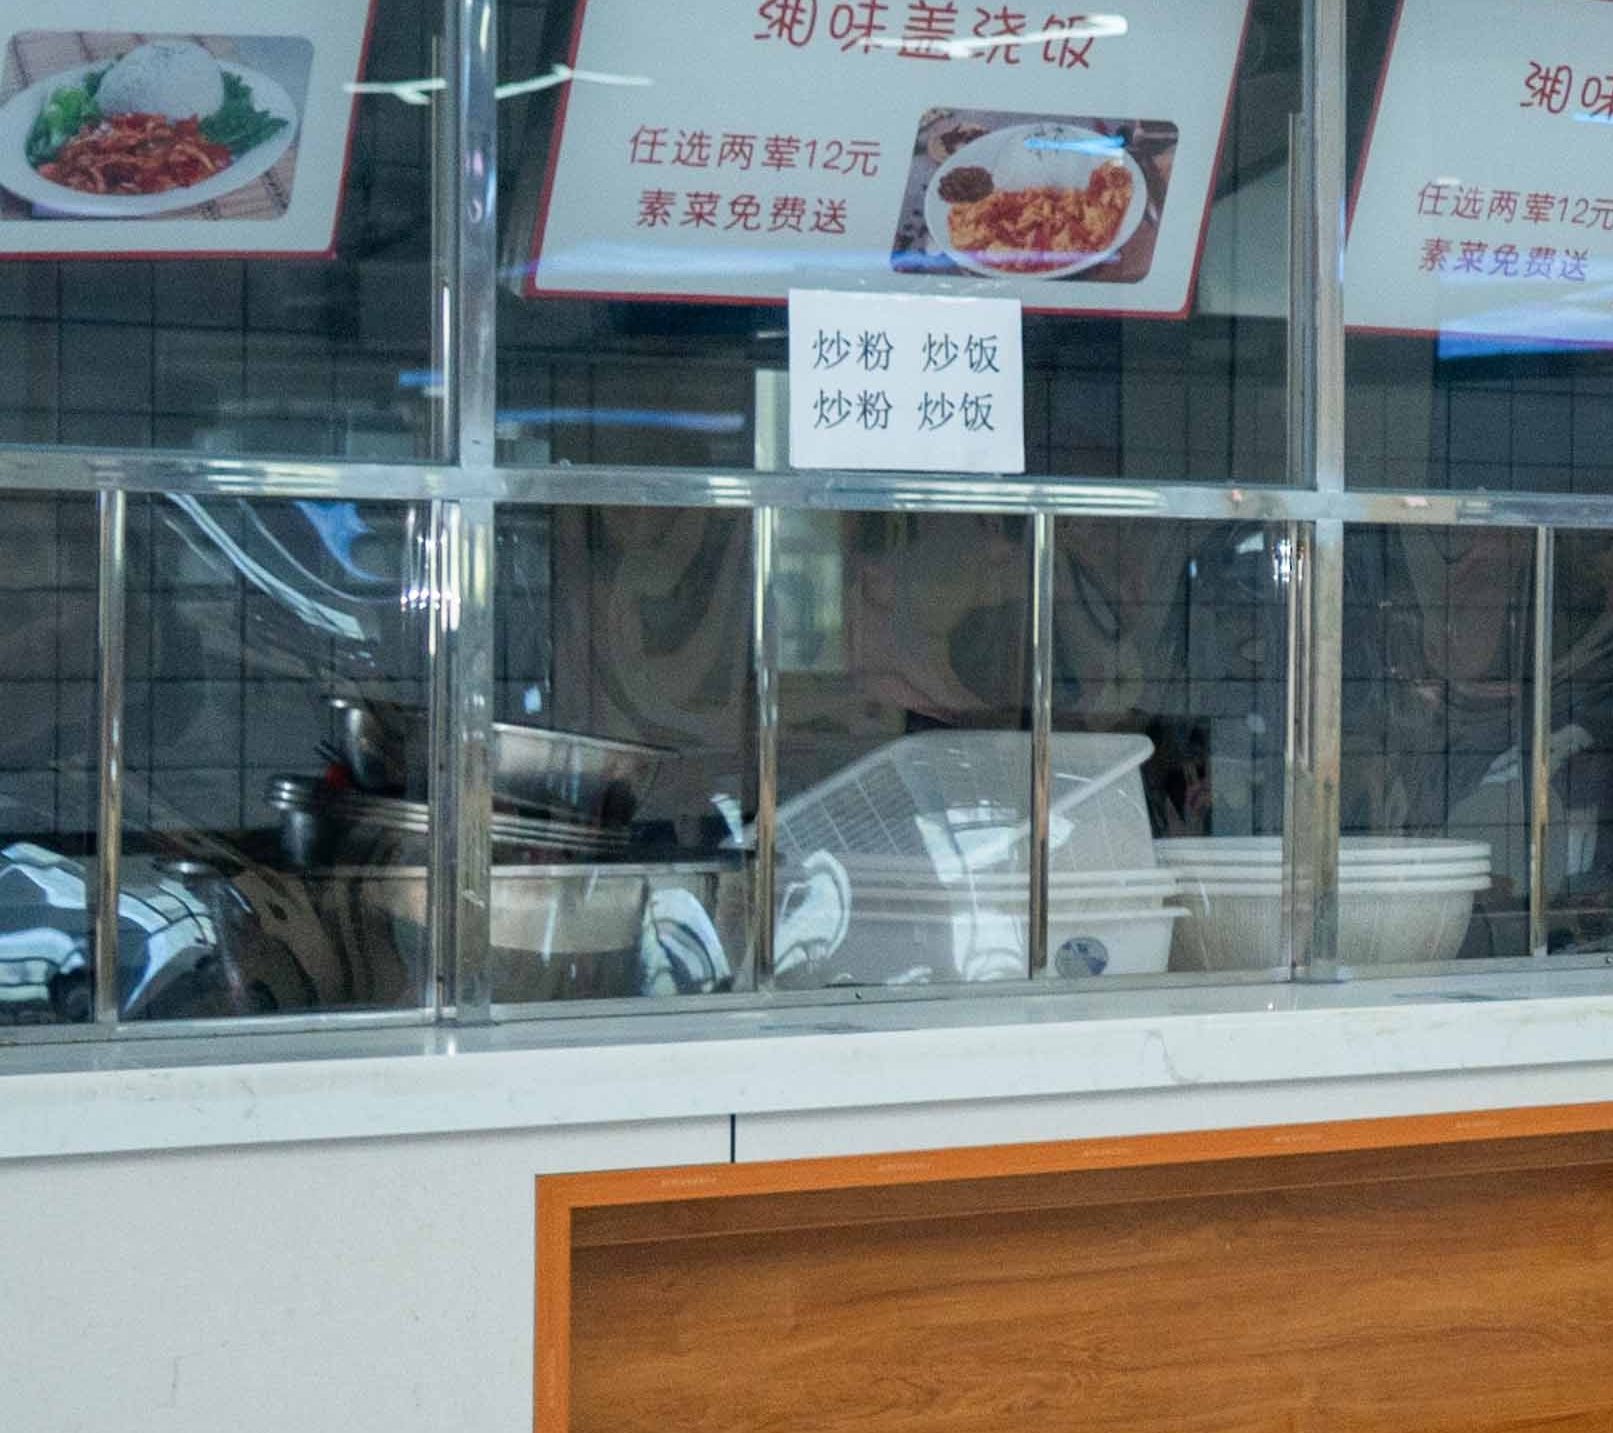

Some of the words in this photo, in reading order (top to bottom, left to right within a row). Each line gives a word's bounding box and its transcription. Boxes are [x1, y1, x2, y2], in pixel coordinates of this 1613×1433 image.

[628, 125, 882, 178] 任选两荤12元
[636, 190, 849, 237] 素菜免费送
[1418, 238, 1590, 284] 素菜免费送
[812, 329, 894, 375] 炒粉
[921, 330, 1001, 376] 炒饭
[812, 390, 893, 432] 炒粉
[917, 390, 996, 433] 炒饭
